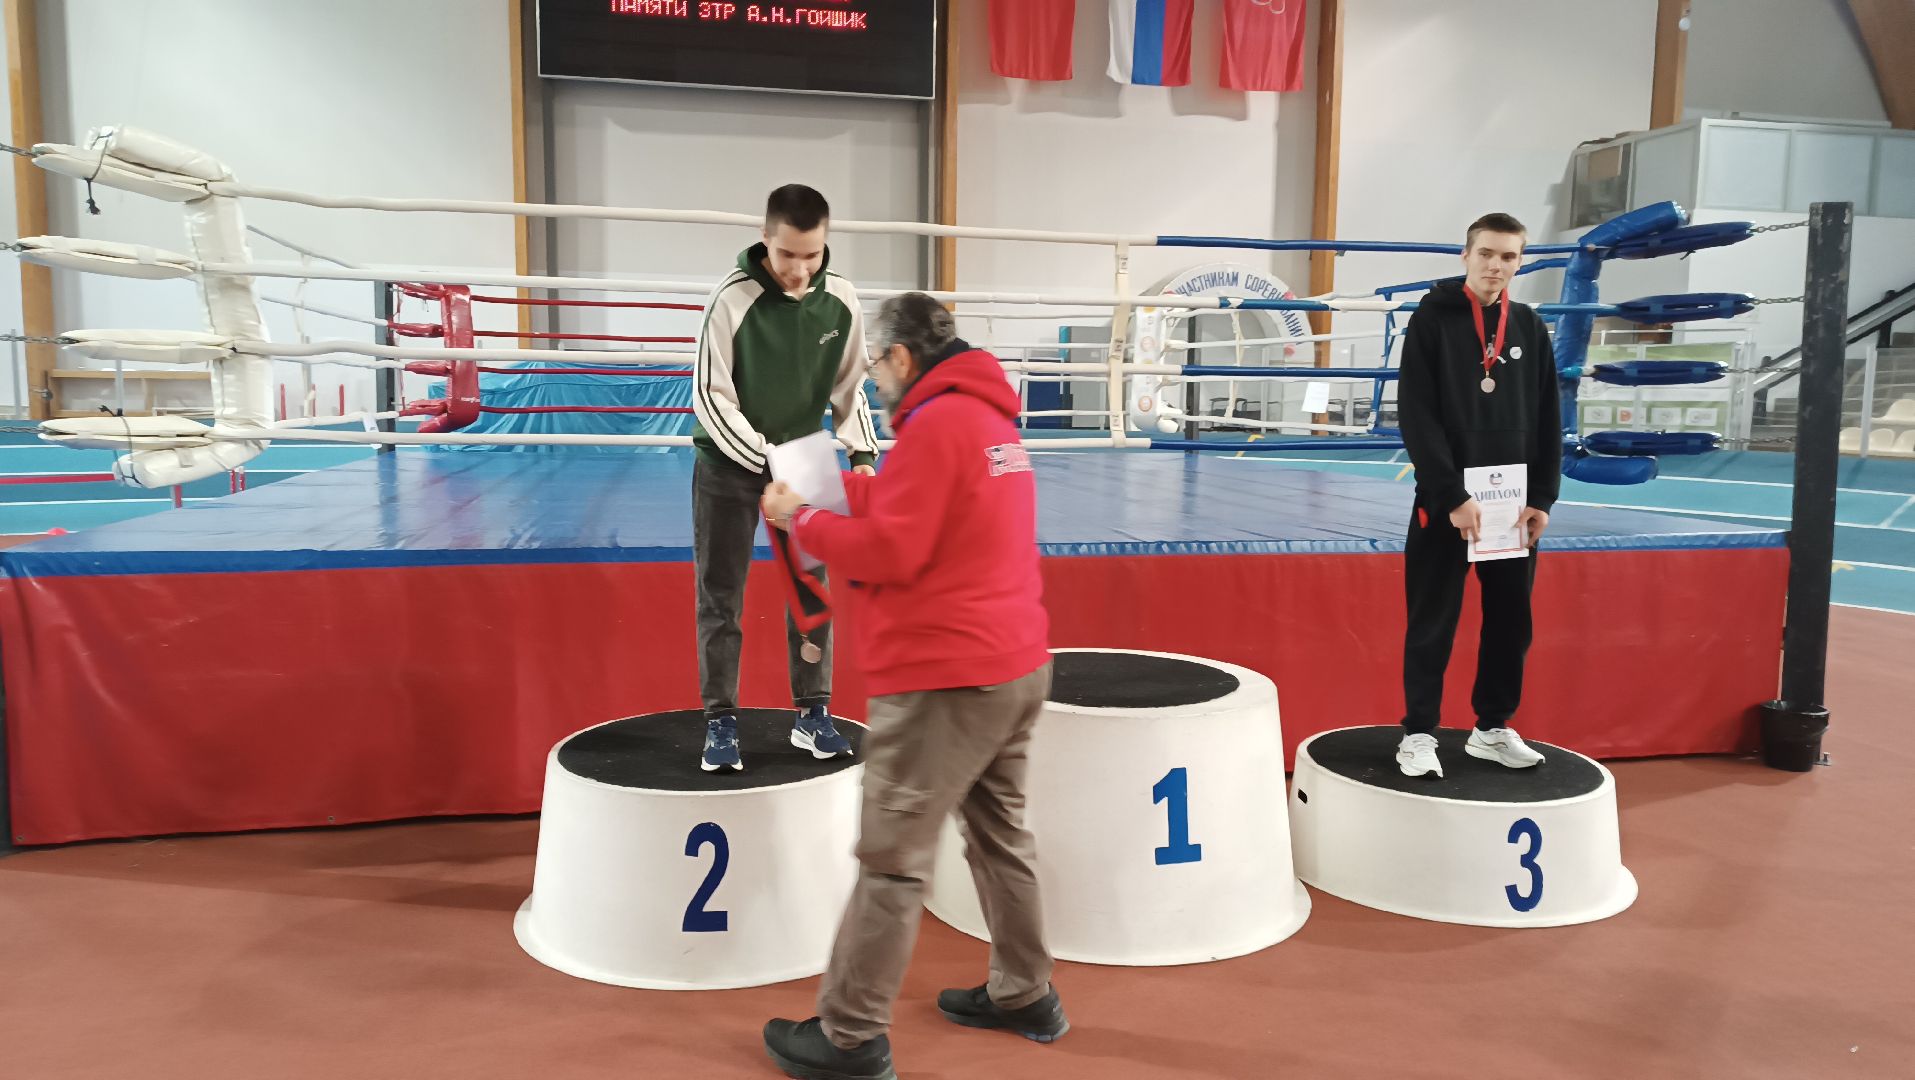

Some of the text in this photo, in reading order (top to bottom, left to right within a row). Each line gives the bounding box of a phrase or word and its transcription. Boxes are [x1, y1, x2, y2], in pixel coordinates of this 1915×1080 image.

[611, 0, 687, 16] ПАМЯТИ
[699, 2, 735, 19] ЗТР
[1153, 767, 1201, 865] 1
[682, 822, 729, 932] 2
[1505, 817, 1543, 912] 3
